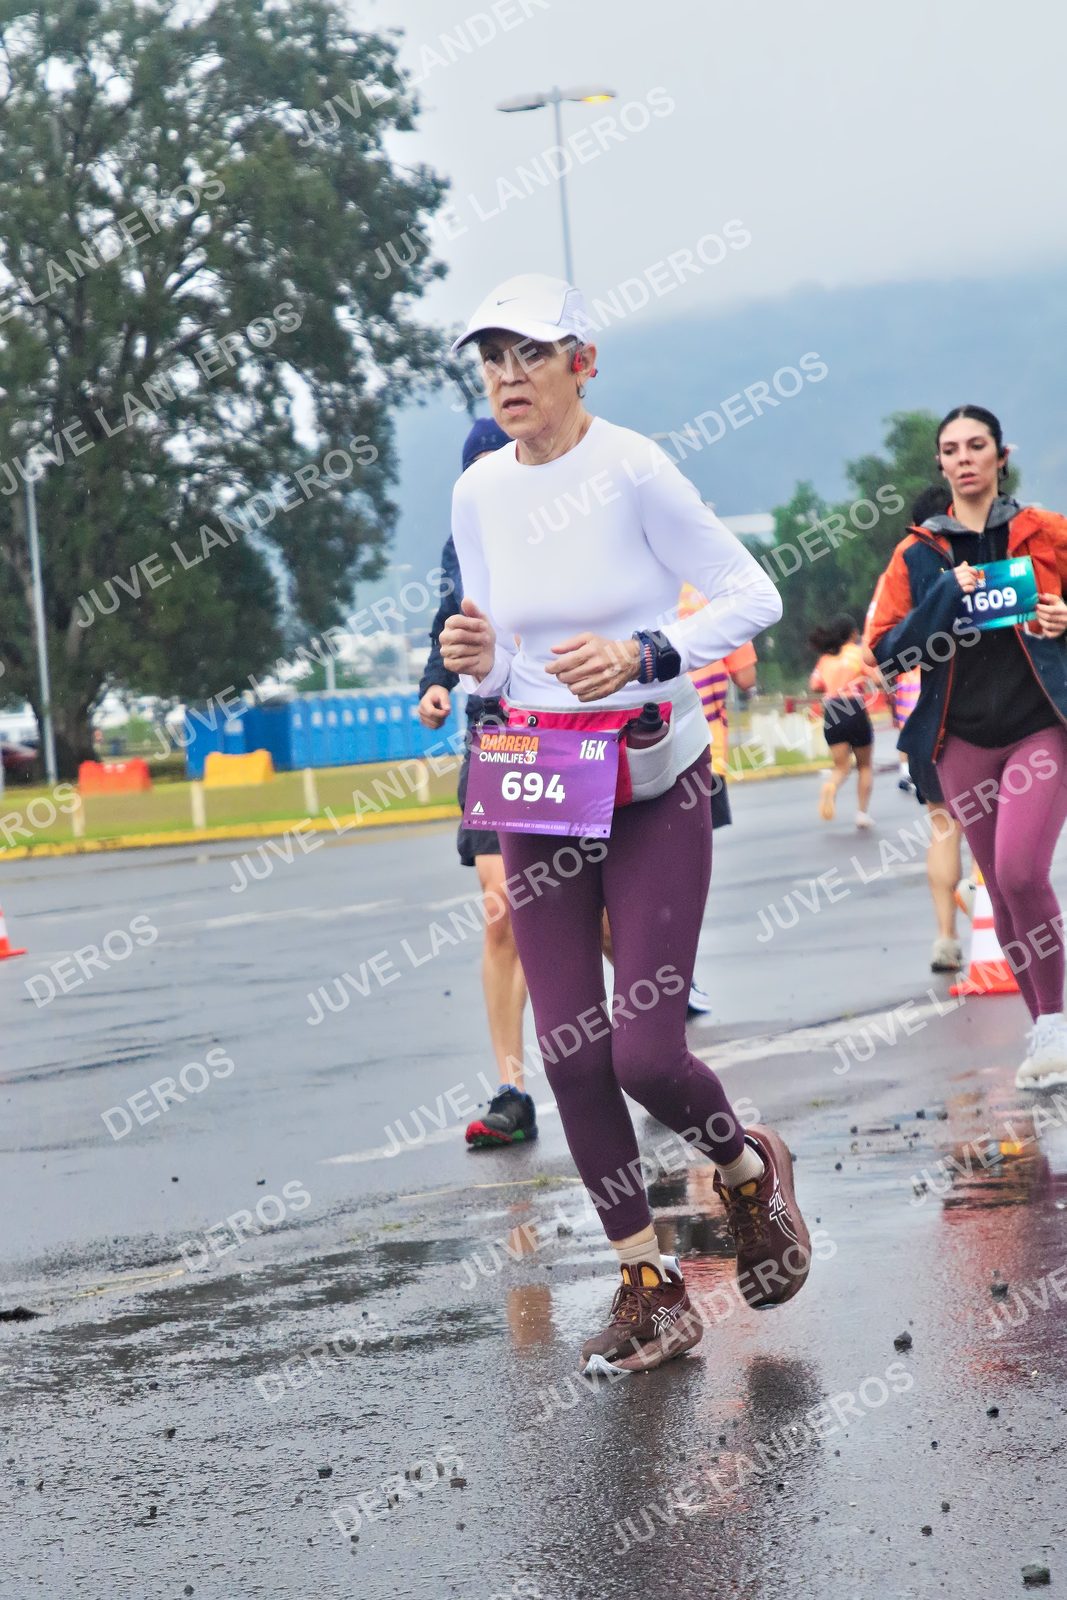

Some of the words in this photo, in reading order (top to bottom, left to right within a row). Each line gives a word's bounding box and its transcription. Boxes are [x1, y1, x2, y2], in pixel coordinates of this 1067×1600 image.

[961, 586, 1018, 613] 1609
[480, 734, 539, 752] CARRERA
[579, 739, 608, 761] 15K
[501, 771, 566, 804] 694
